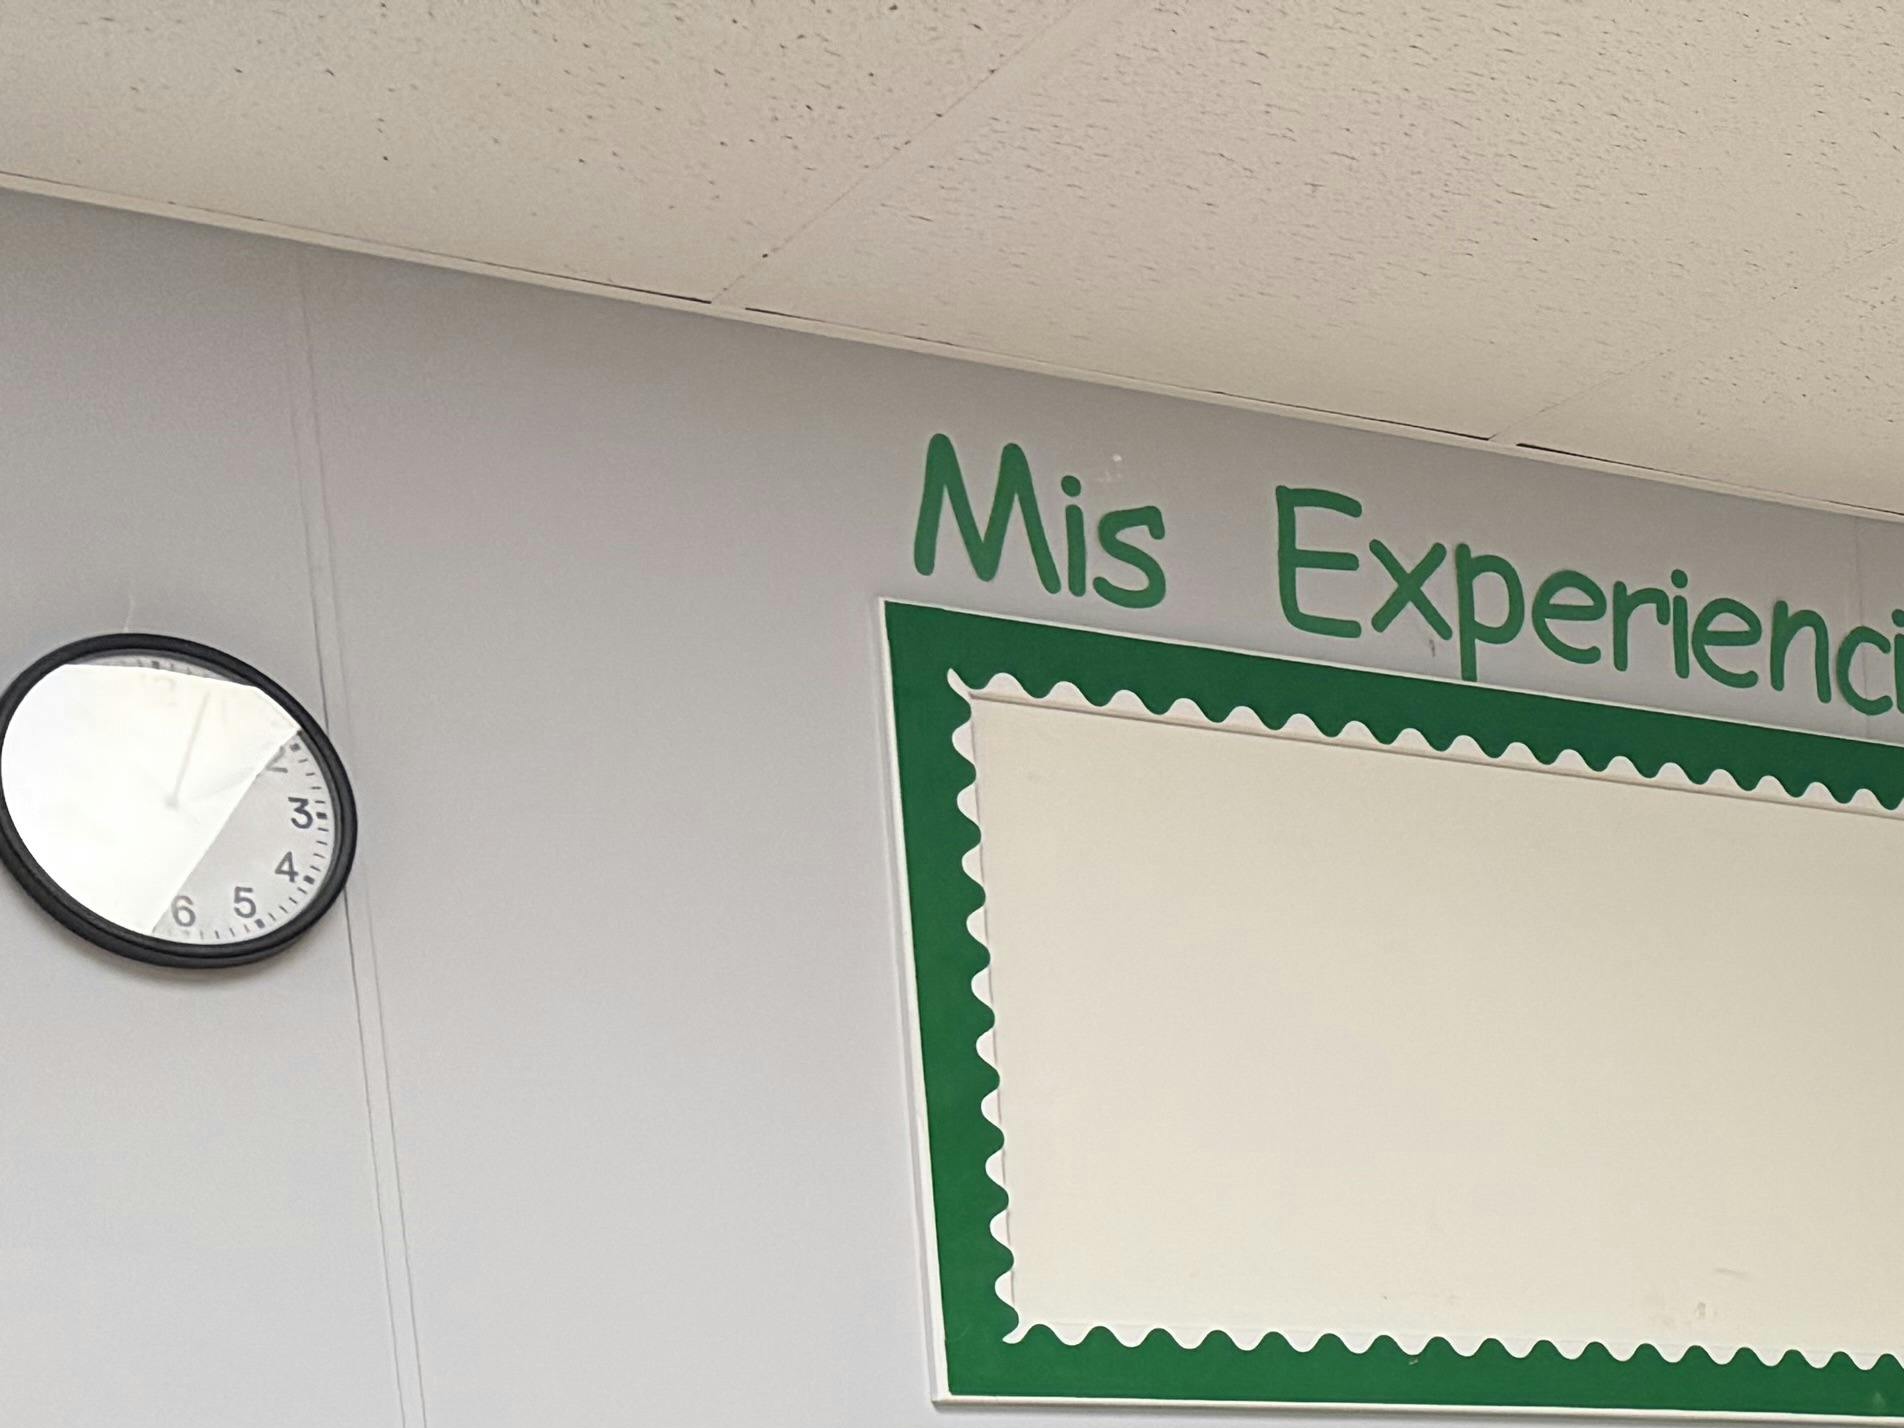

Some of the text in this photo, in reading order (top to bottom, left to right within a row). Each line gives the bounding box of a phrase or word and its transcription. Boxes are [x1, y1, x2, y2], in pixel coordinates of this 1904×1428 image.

[914, 433, 1167, 609] Mis
[287, 796, 313, 829] 3
[274, 850, 299, 883] 4
[170, 895, 196, 927] 6
[232, 886, 257, 919] 5
